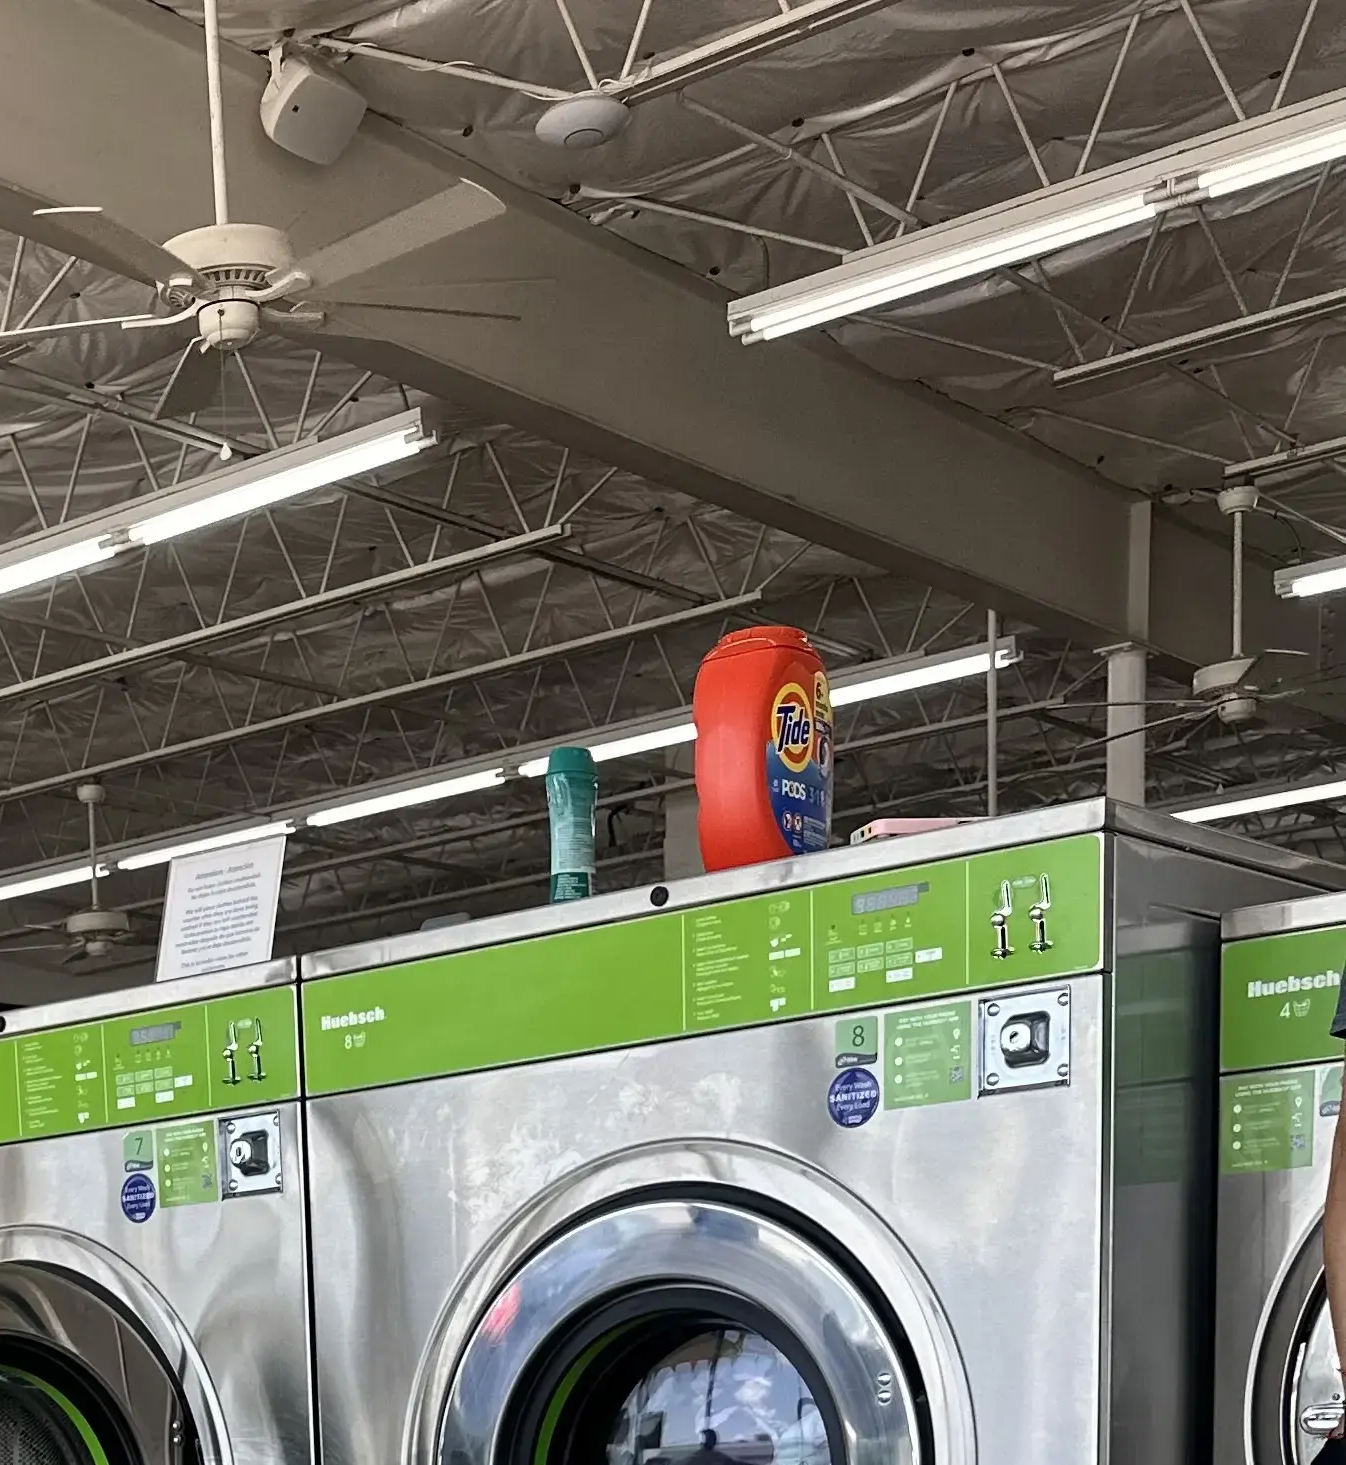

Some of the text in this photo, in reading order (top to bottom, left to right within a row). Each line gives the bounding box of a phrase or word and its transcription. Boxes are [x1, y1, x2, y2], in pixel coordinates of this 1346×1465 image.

[776, 704, 810, 754] Tide
[782, 779, 806, 800] PODS
[1247, 970, 1341, 998] Huebsch
[321, 1006, 385, 1031] Huebsch
[1279, 1002, 1291, 1018] 4
[344, 1034, 352, 1050] 8
[853, 1025, 865, 1047] 8
[829, 1089, 878, 1103] SANITIZED
[135, 1137, 143, 1155] 7
